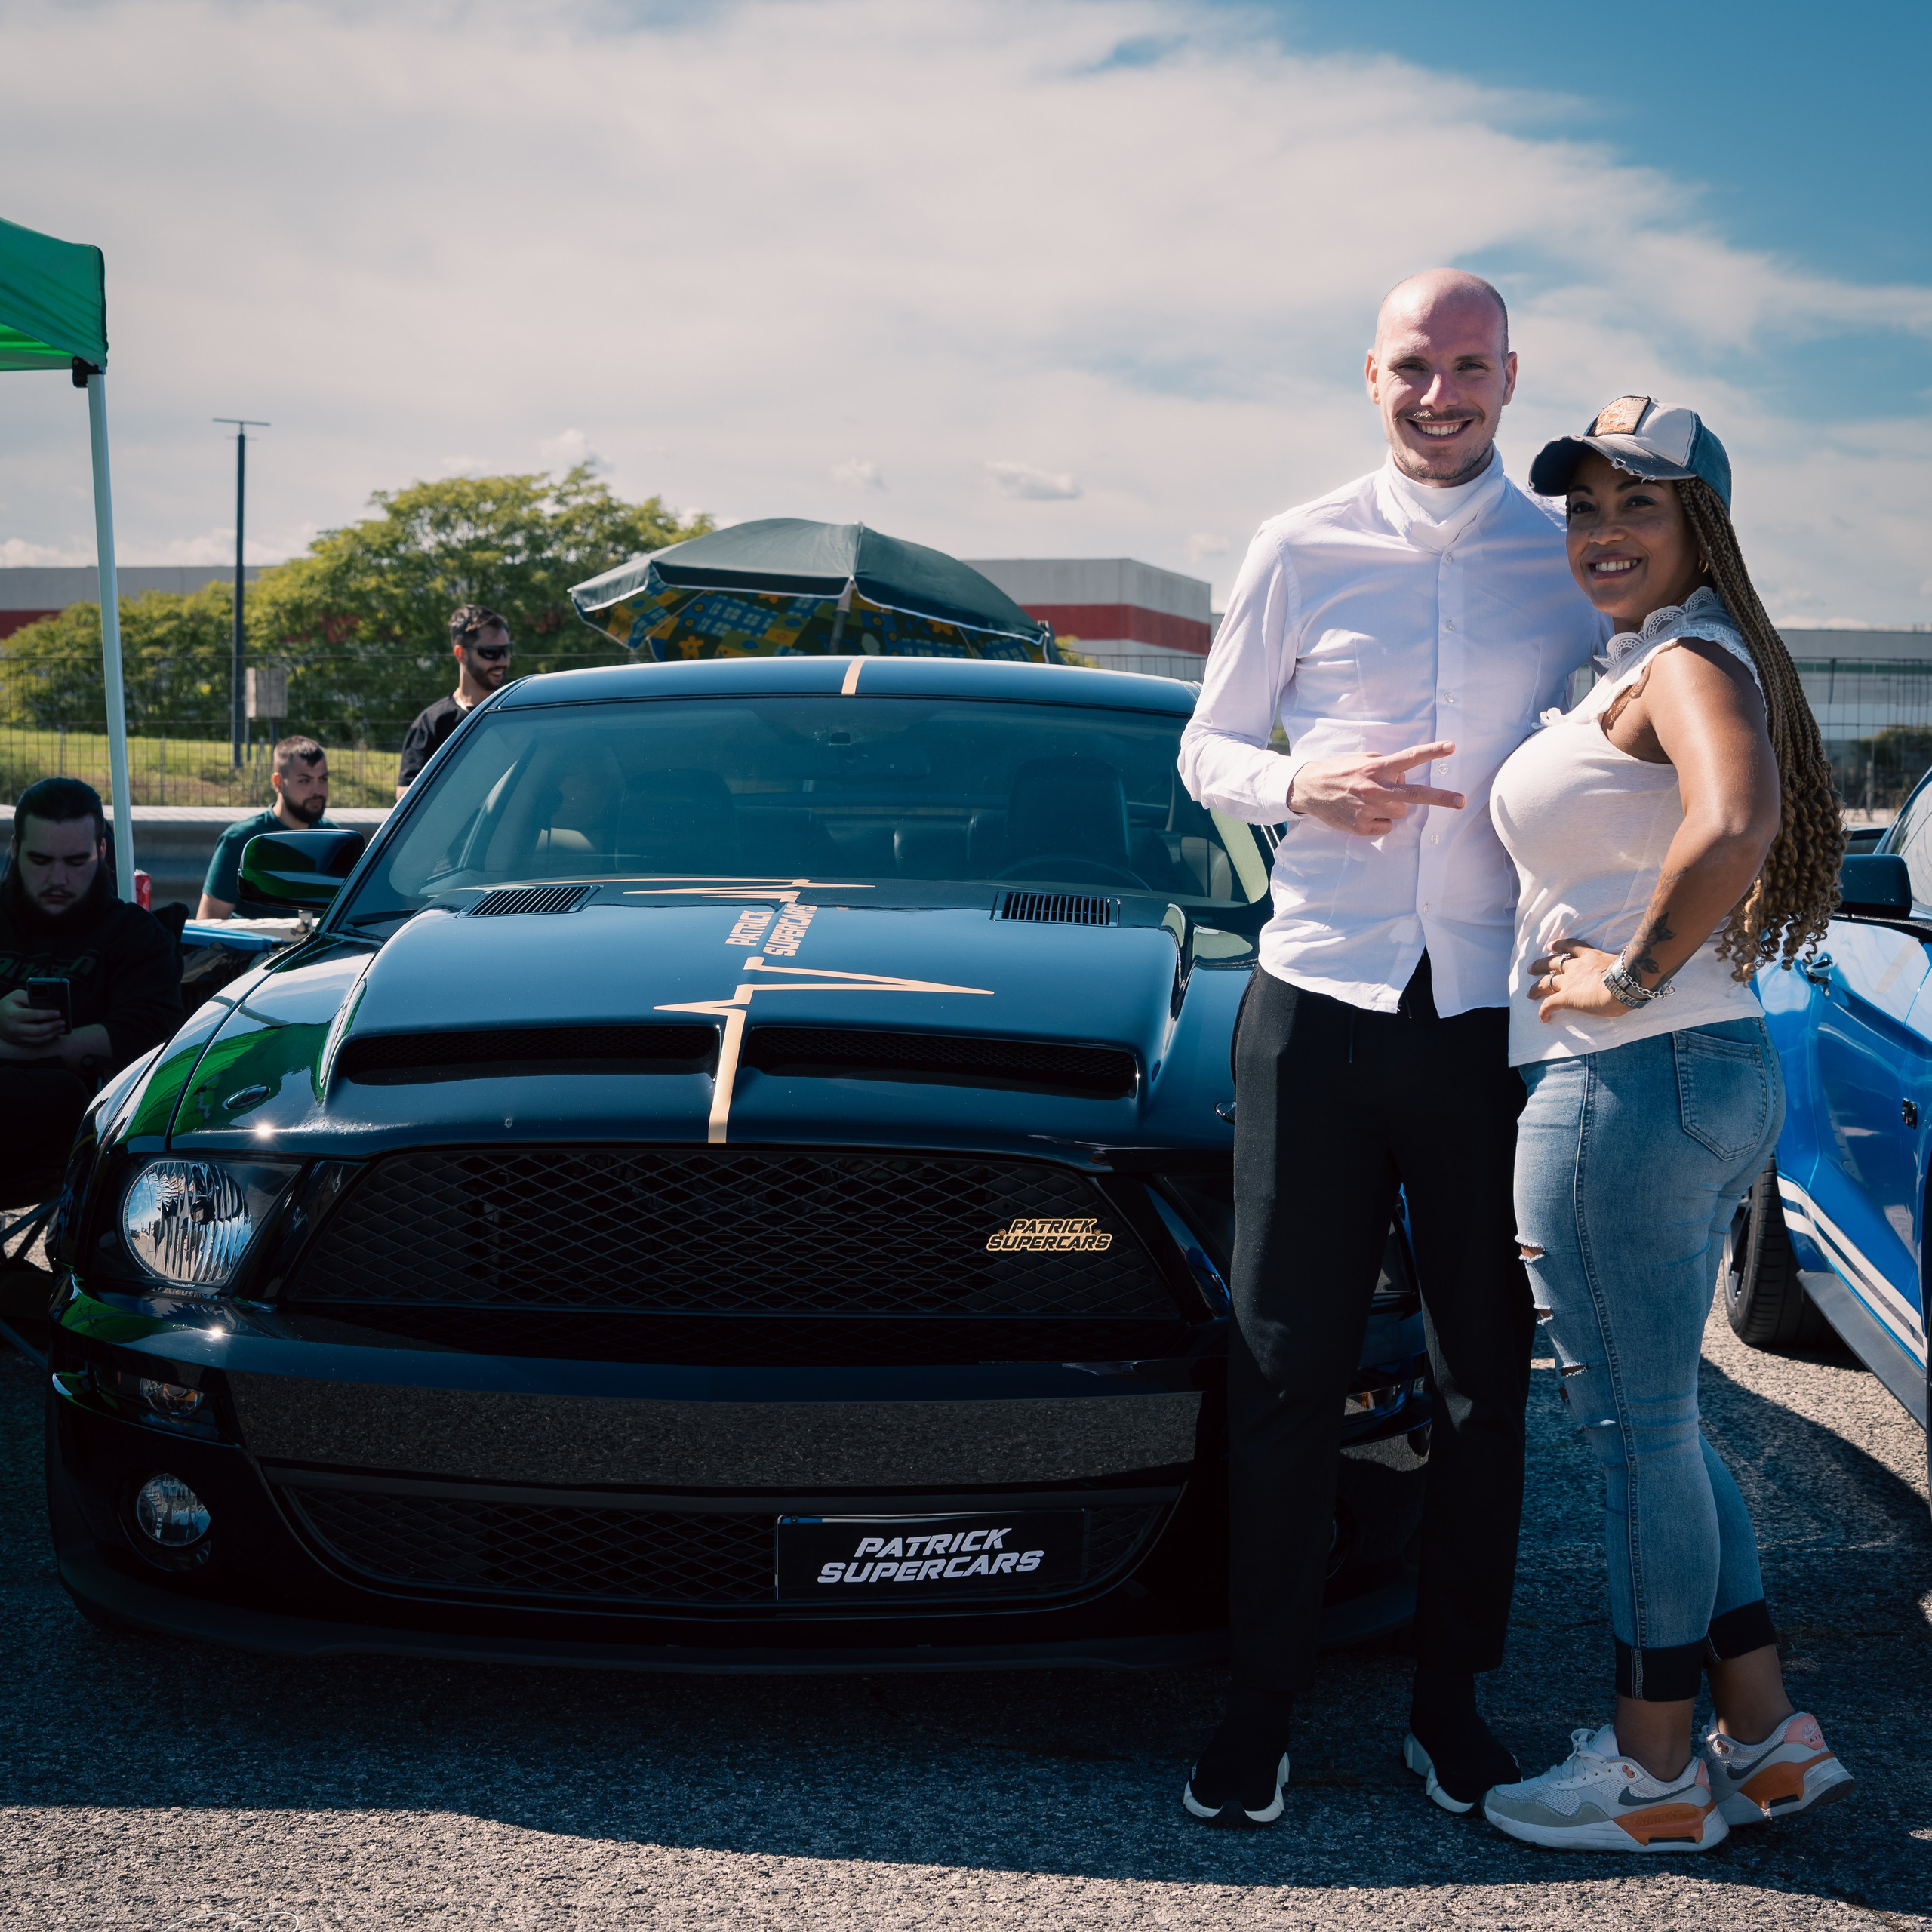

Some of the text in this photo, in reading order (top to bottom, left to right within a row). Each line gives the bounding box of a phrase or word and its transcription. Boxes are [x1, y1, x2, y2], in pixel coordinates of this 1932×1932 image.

[724, 910, 774, 946] PATRICK
[762, 903, 818, 957] SUPERCARS
[987, 1234, 1112, 1251] SUPERCARS
[1009, 1219, 1097, 1234] PATRICK
[854, 1527, 1013, 1558] PATRICK
[817, 1550, 1044, 1583] SUPERCARS
